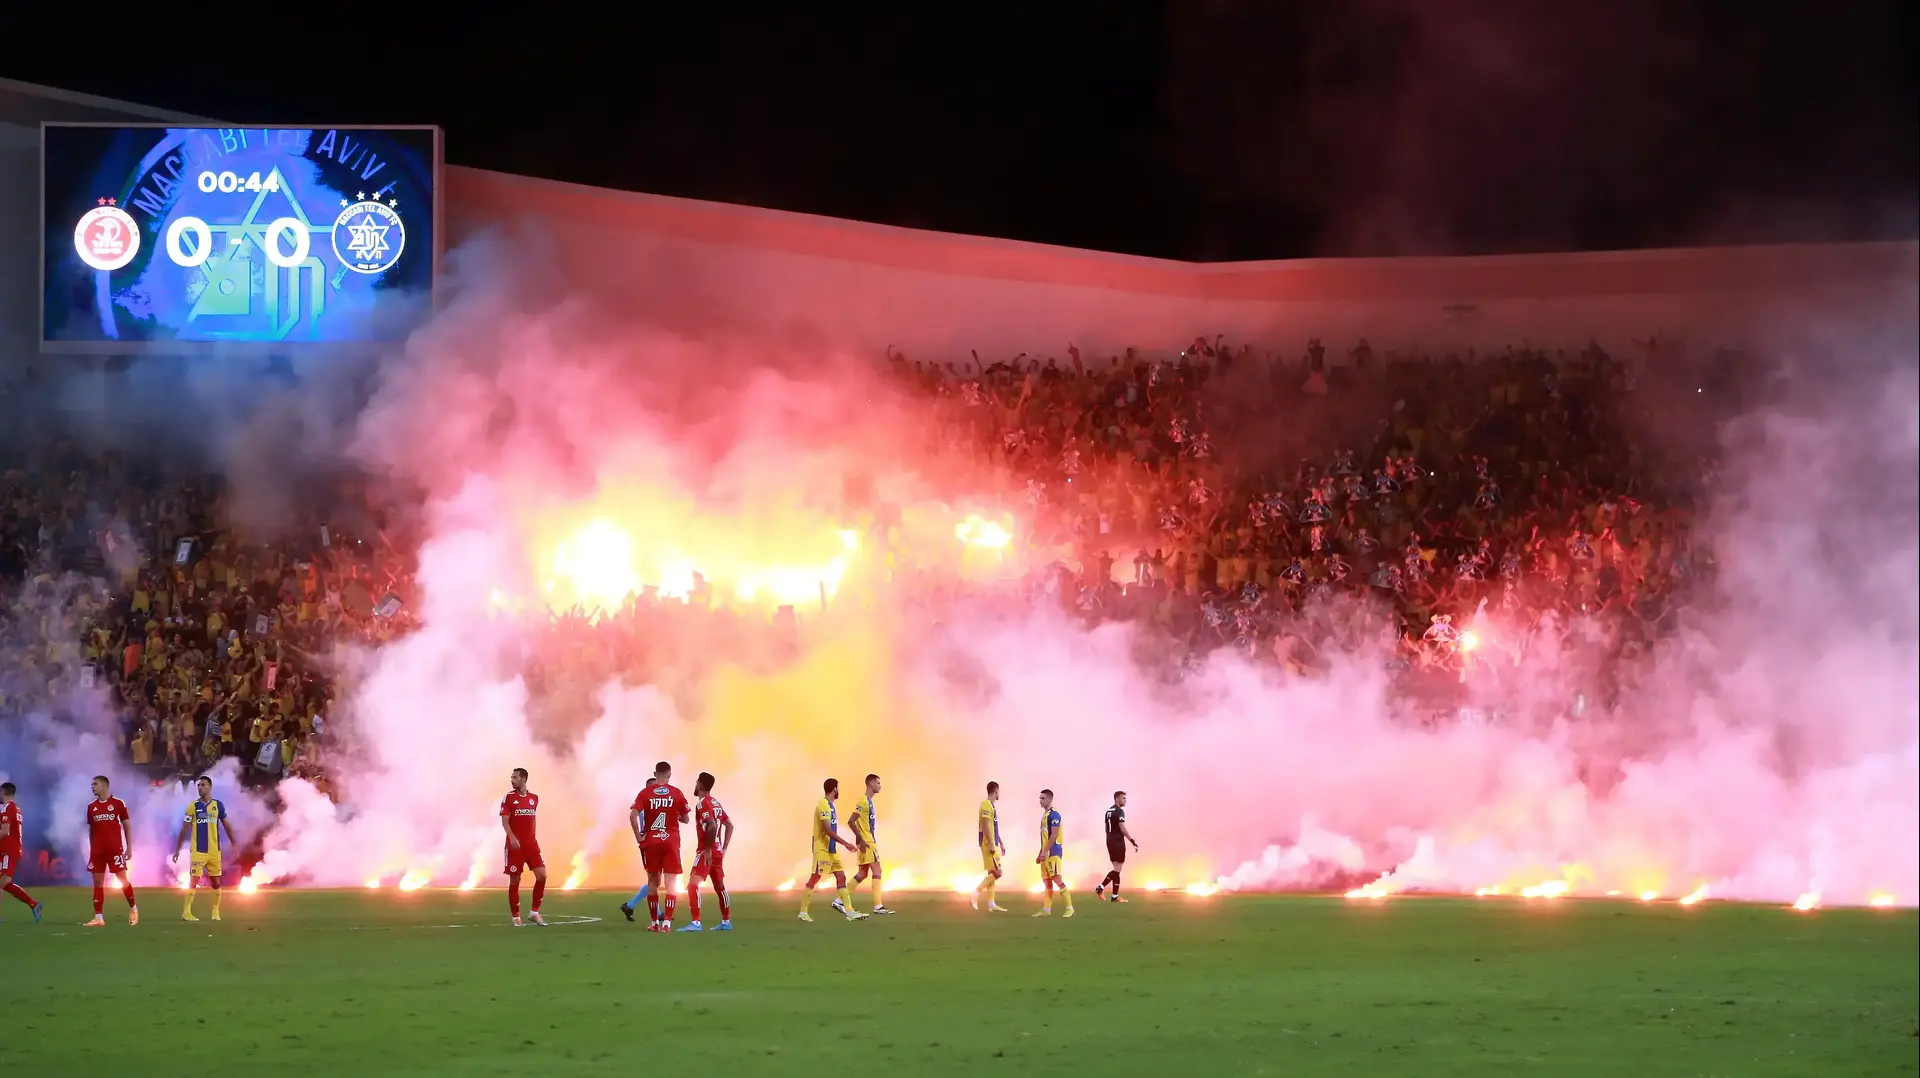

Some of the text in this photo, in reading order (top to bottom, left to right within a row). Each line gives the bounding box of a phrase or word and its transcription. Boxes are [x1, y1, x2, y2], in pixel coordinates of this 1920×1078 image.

[316, 129, 386, 181] AVIV
[198, 171, 279, 193] 00:44
[339, 206, 363, 226] MACCABI
[365, 205, 375, 213] TEL
[377, 207, 392, 218] AVIV
[166, 216, 212, 267] 0
[265, 216, 310, 267] 0
[651, 812, 666, 830] 4
[114, 855, 124, 866] 21
